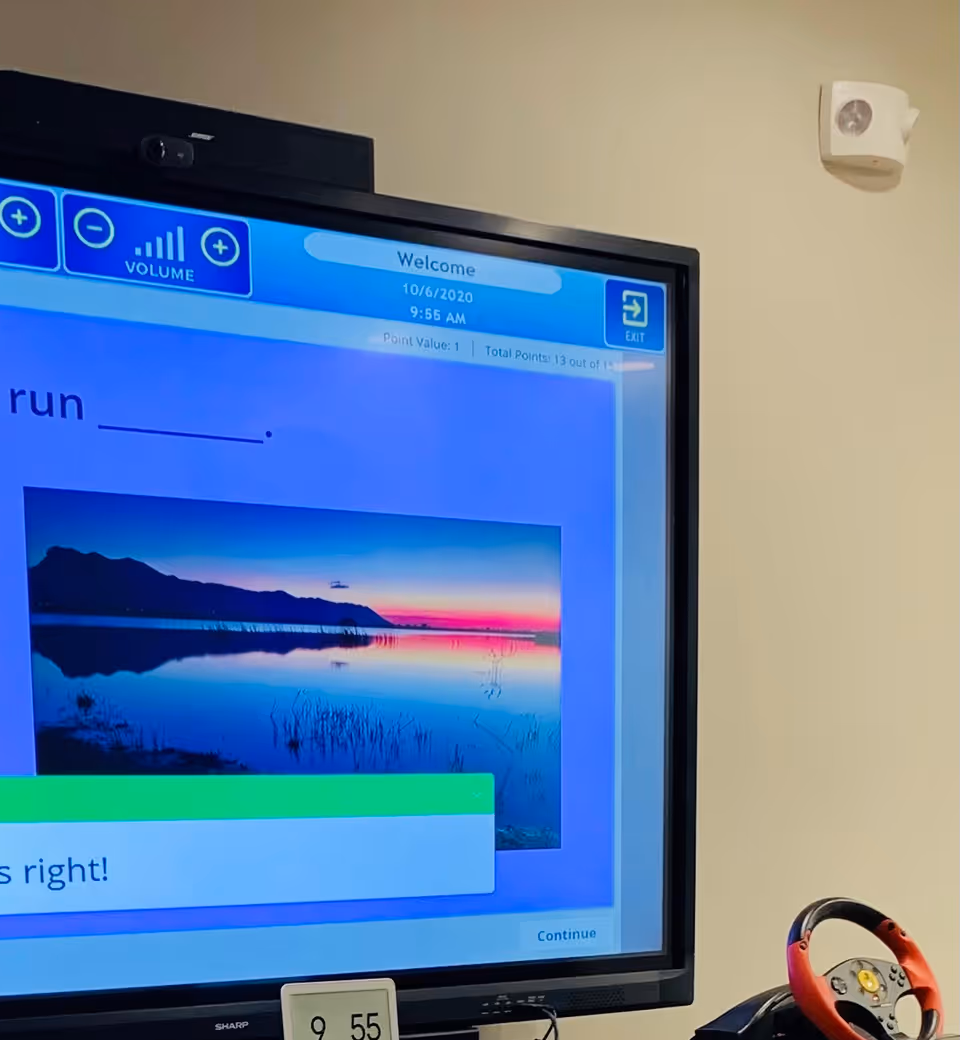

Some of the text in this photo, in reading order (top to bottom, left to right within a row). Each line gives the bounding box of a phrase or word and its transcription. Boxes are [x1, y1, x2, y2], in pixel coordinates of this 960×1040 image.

[125, 260, 194, 282] VOLUME
[397, 251, 476, 277] Welcome
[402, 283, 474, 304] 10/6/2020
[410, 306, 467, 325] 9:55 AM
[383, 332, 414, 347] Point
[417, 335, 451, 352] Value:
[625, 330, 645, 343] EXIT
[485, 345, 512, 360] Total
[515, 349, 551, 364] Points:
[554, 353, 567, 366] 13
[569, 357, 586, 370] out
[589, 359, 600, 371] of
[9, 386, 85, 420] run
[24, 857, 108, 891] right!
[537, 927, 597, 942] Continue
[215, 1021, 249, 1031] SHARP
